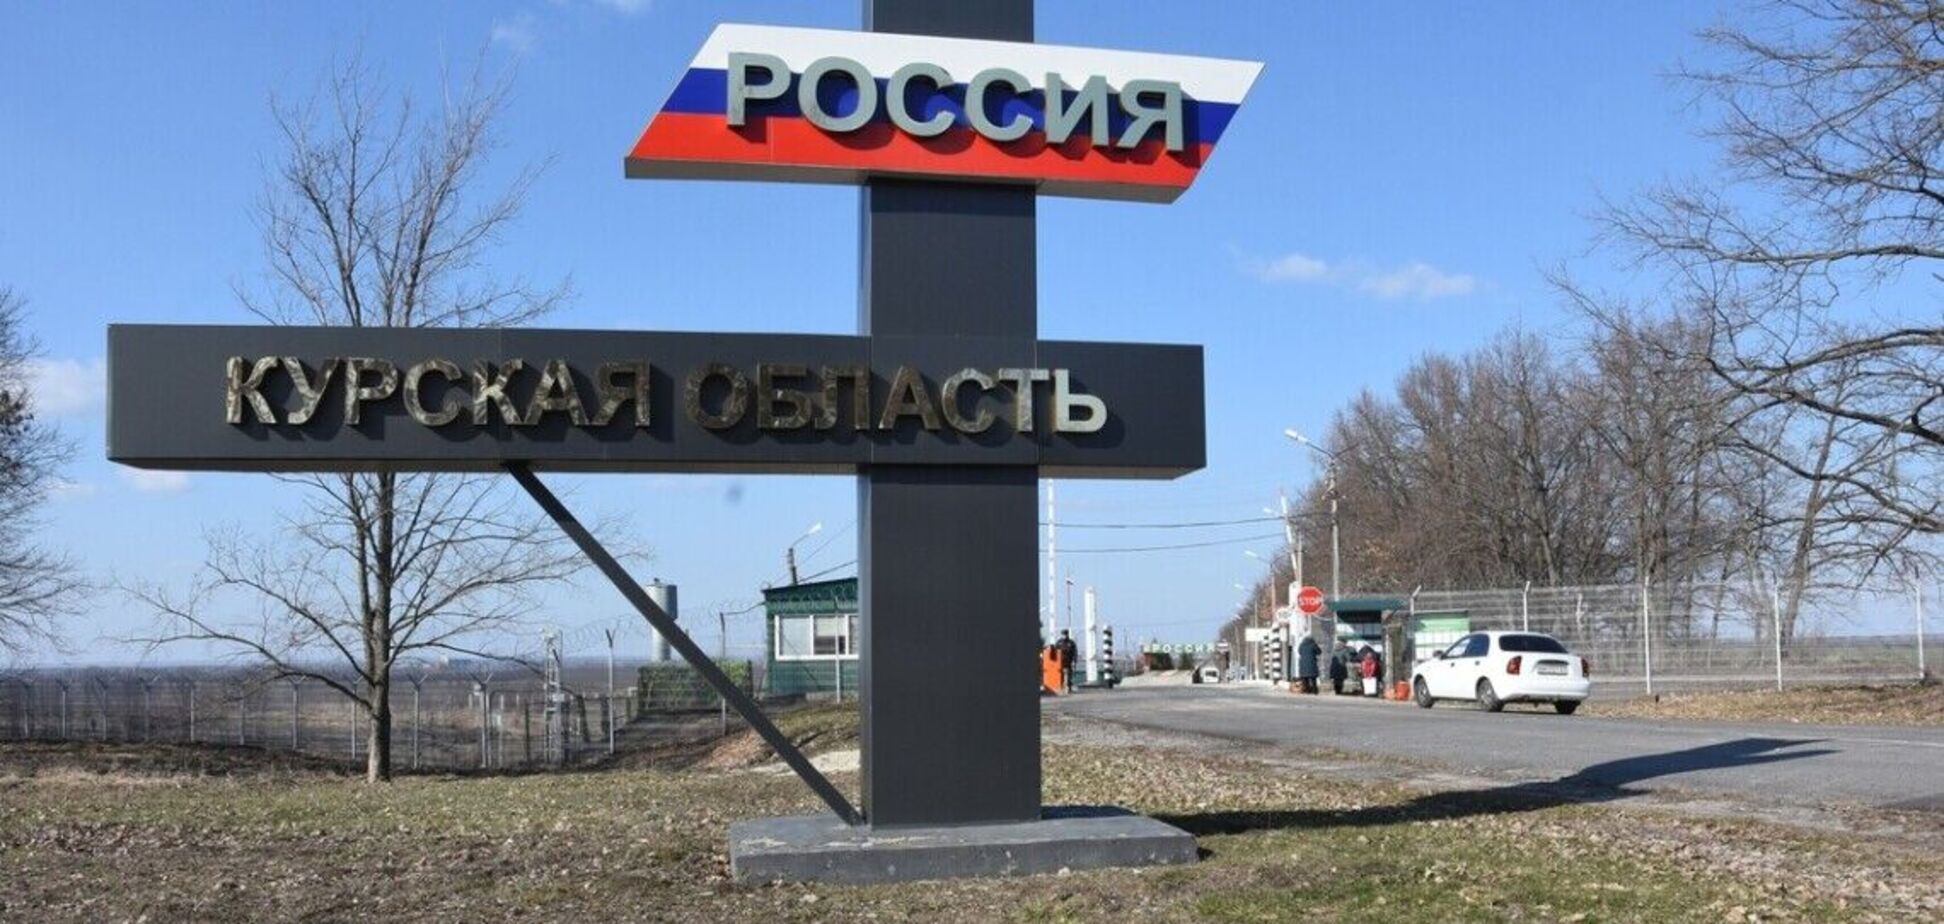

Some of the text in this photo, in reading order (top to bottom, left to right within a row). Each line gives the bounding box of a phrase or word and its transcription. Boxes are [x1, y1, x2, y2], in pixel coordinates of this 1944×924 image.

[726, 51, 1184, 152] РОССИЯ
[225, 356, 1108, 434] КУРСКАЯ ОБЛАСТЬ
